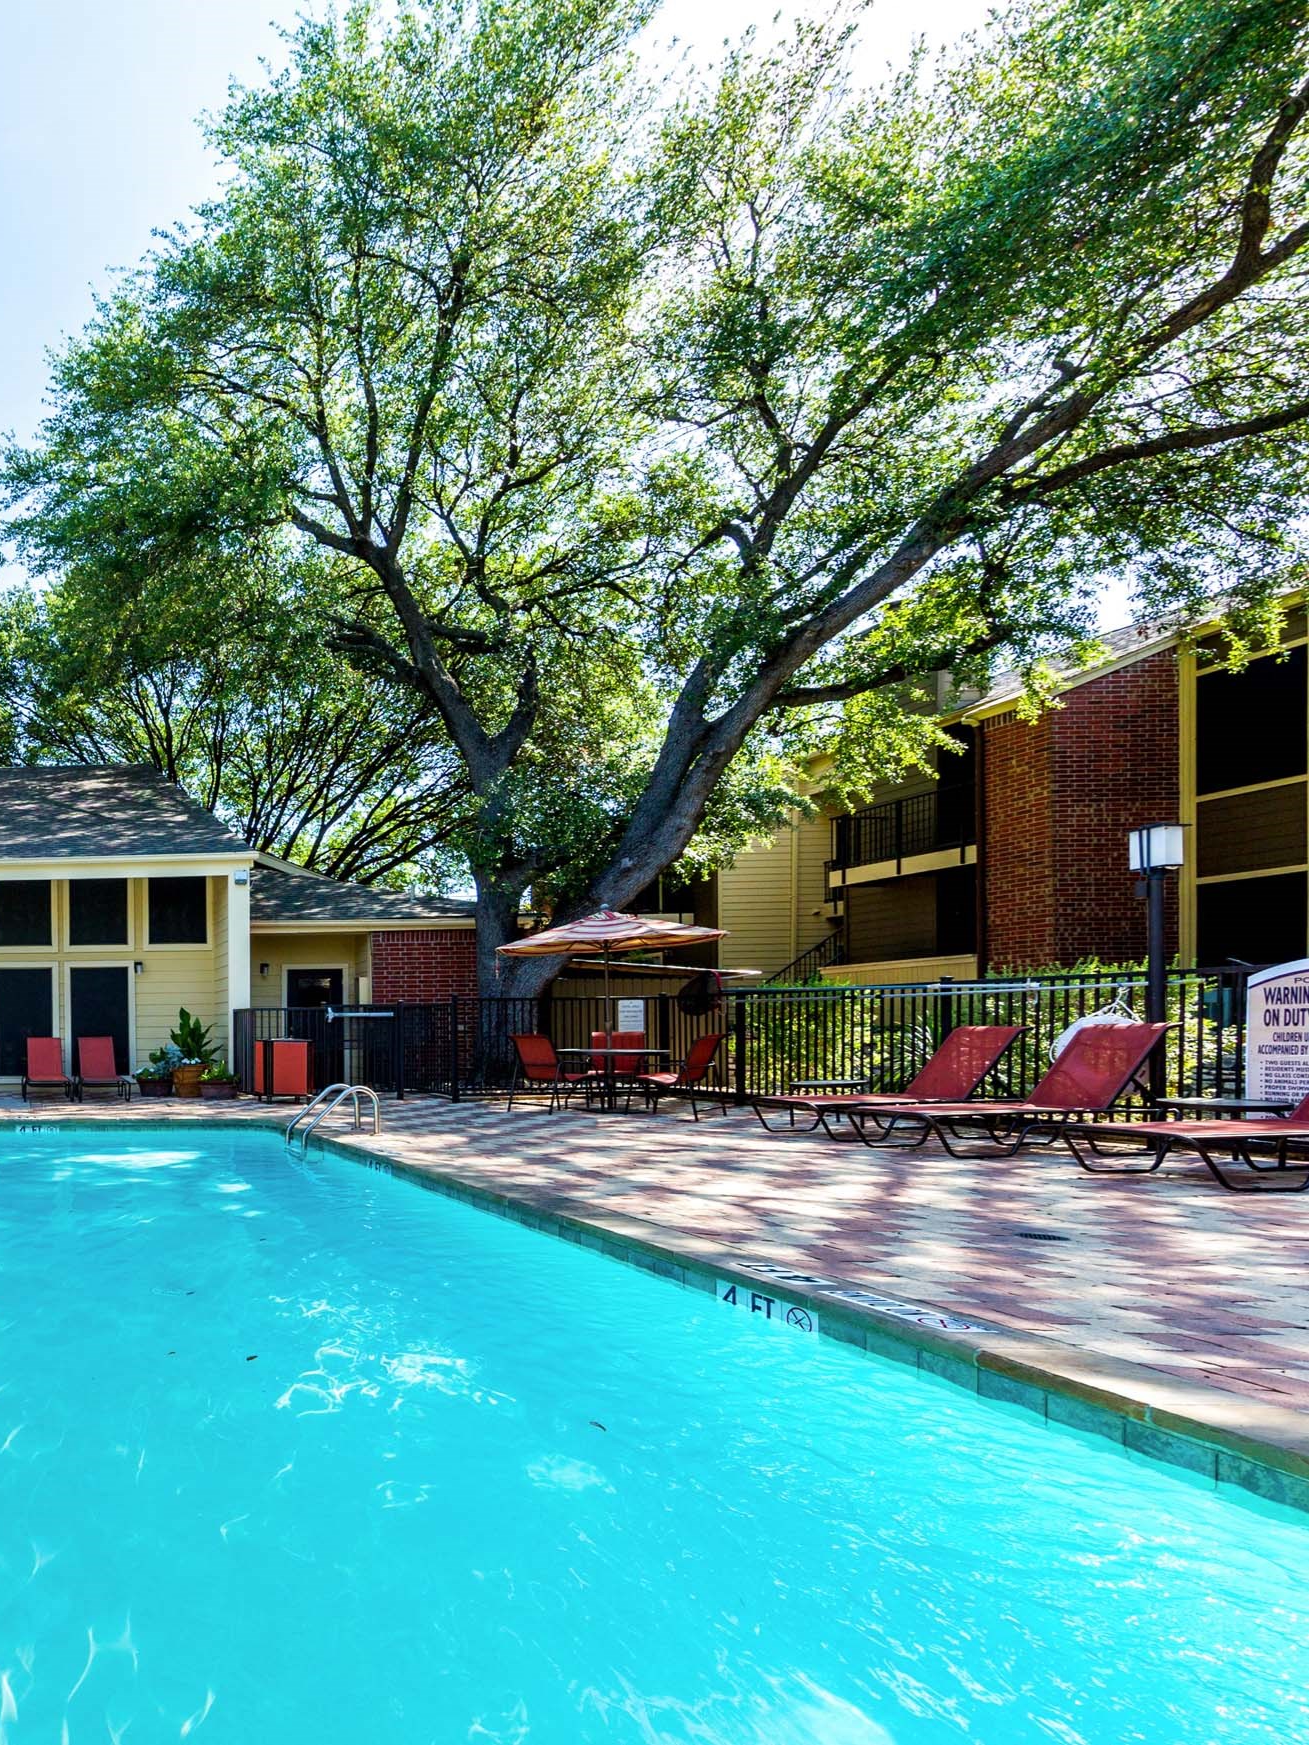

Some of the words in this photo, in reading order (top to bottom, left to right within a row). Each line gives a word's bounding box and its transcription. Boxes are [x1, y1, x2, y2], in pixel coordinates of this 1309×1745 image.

[1263, 1008, 1280, 1027] ON
[1284, 1007, 1309, 1027] DUT
[1272, 1031, 1303, 1042] CHILDREN
[1258, 1044, 1299, 1055] ACCOMPANIED
[1301, 1045, 1309, 1055] BY
[751, 1292, 775, 1319] FT
